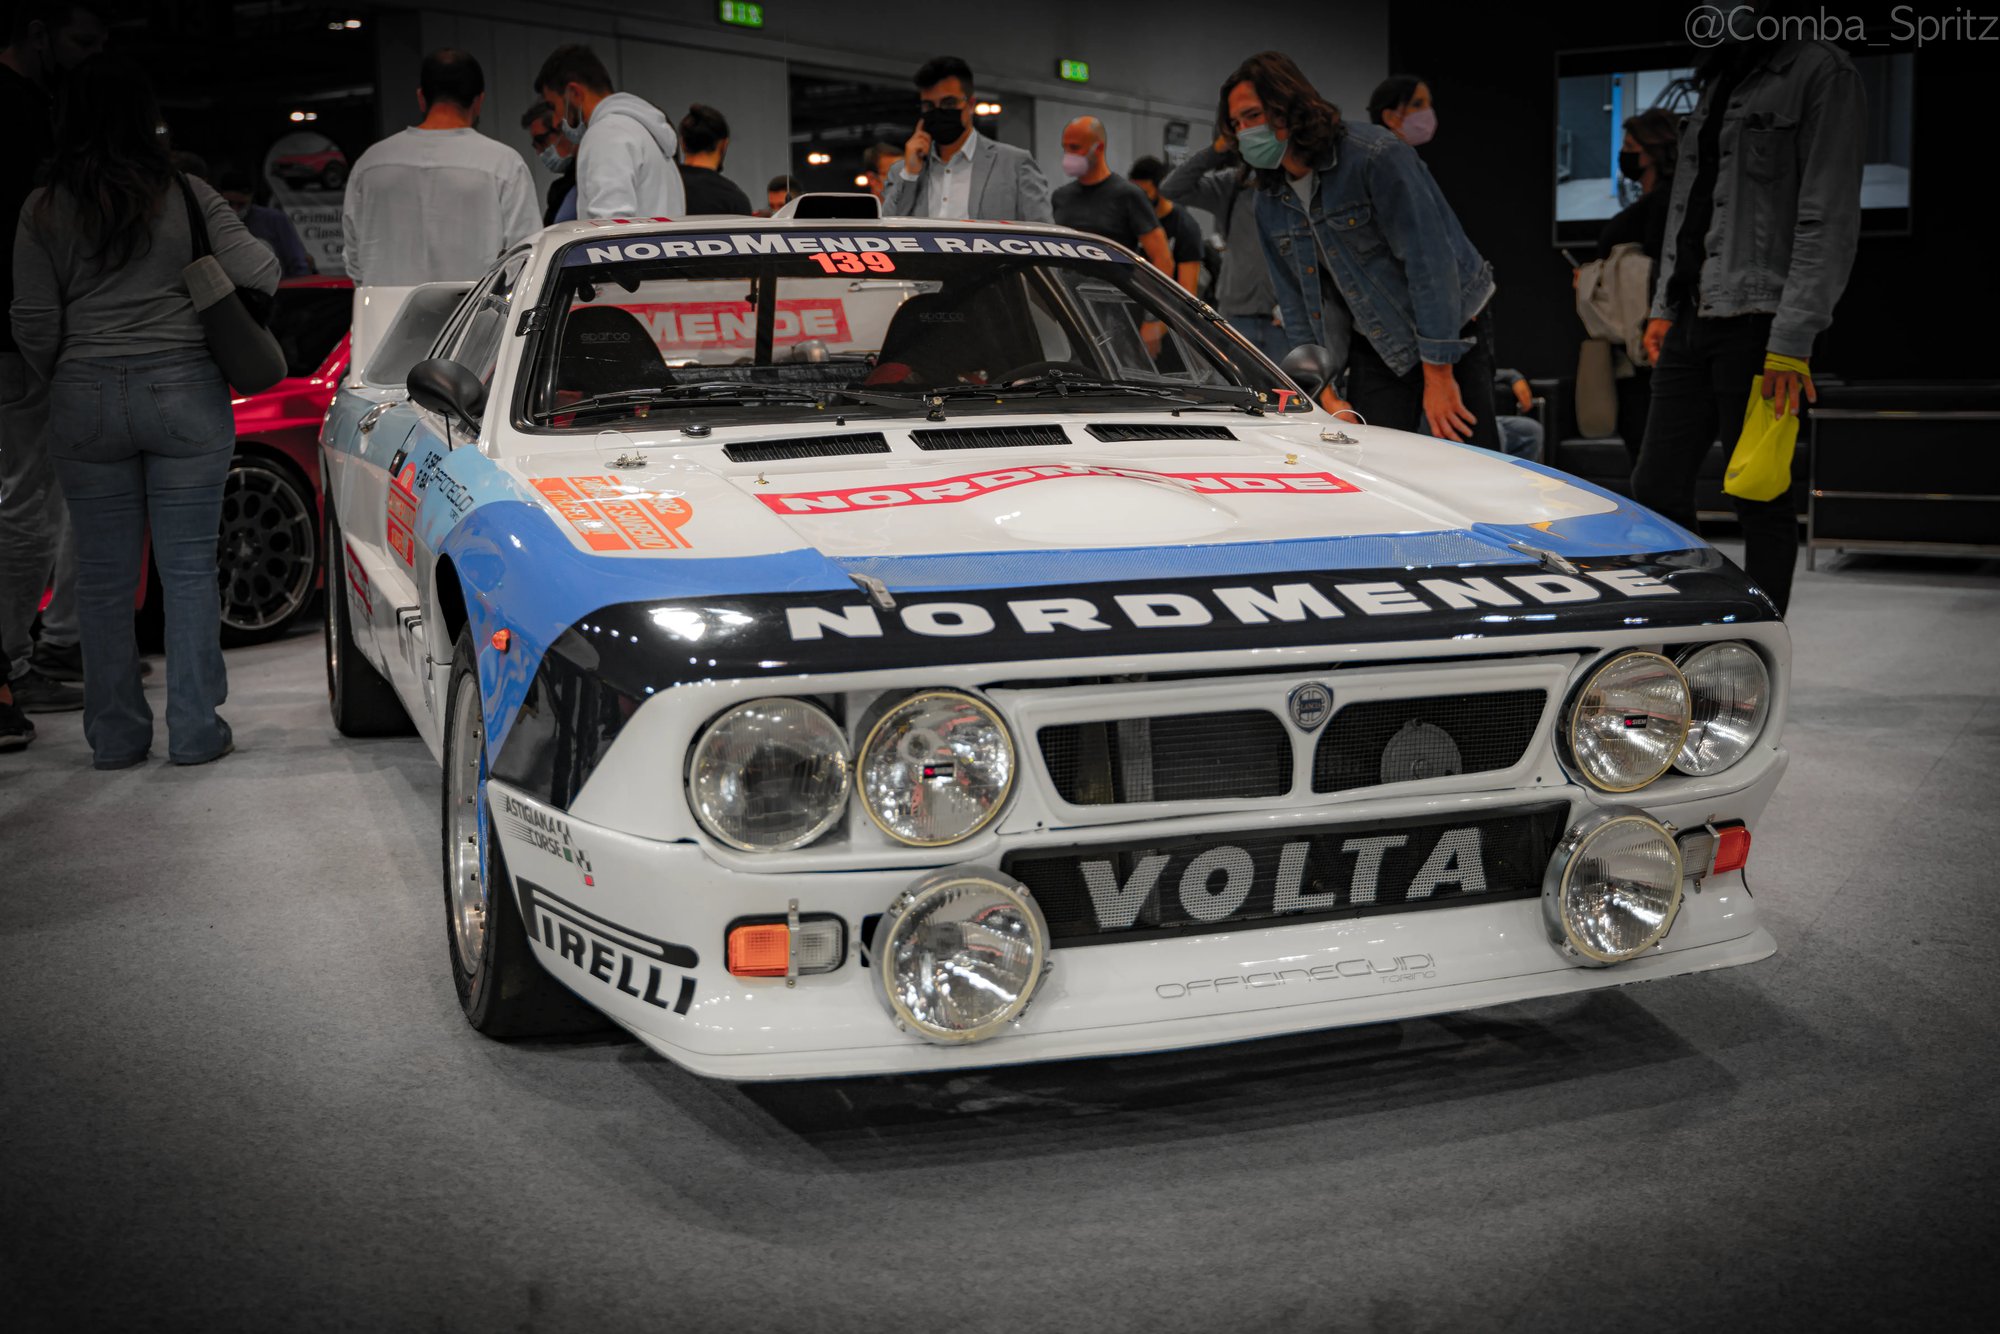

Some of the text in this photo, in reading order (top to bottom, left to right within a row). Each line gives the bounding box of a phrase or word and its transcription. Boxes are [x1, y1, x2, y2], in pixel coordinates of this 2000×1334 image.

[586, 234, 1112, 264] NORDMENDE RACING
[808, 251, 896, 274] 139
[580, 331, 632, 343] sparco
[785, 569, 1680, 640] NORDMENDE
[506, 795, 557, 836] ASTIGIANA
[528, 827, 564, 859] CORSE
[1079, 826, 1488, 929] VOLTA
[516, 876, 699, 1016] PIRELLI
[1379, 970, 1437, 984] TORINO
